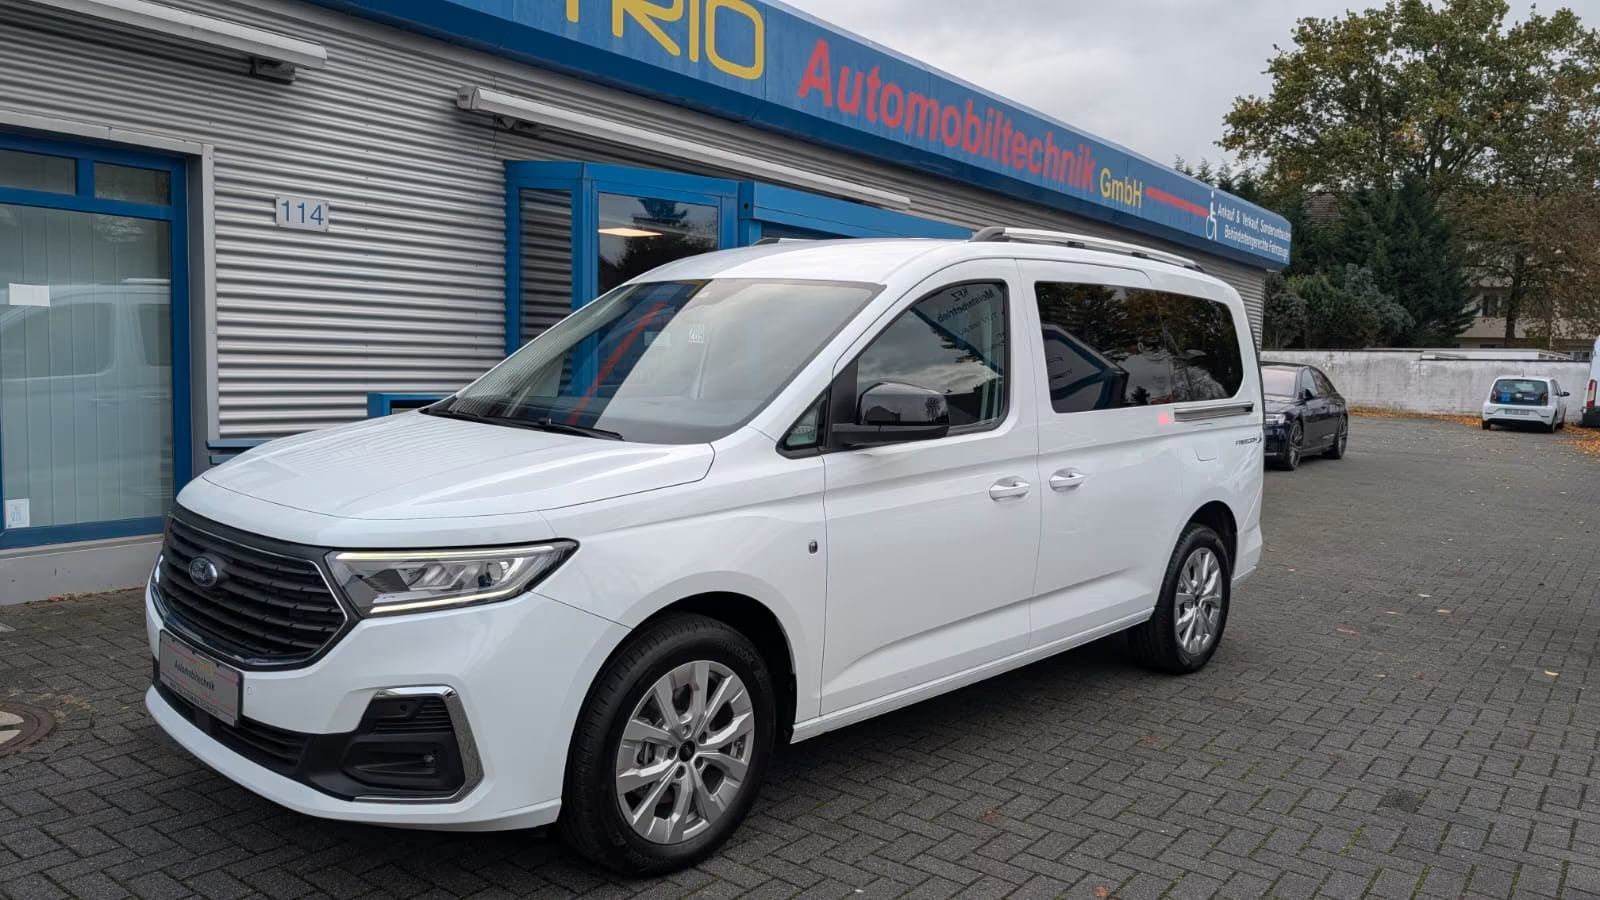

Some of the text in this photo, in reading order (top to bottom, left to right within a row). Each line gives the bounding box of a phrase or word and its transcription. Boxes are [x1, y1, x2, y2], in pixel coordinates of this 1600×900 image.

[566, 0, 1143, 208] RIO Automobiltechnik GmbH
[281, 199, 324, 226] 114
[1217, 203, 1235, 221] Ankauf
